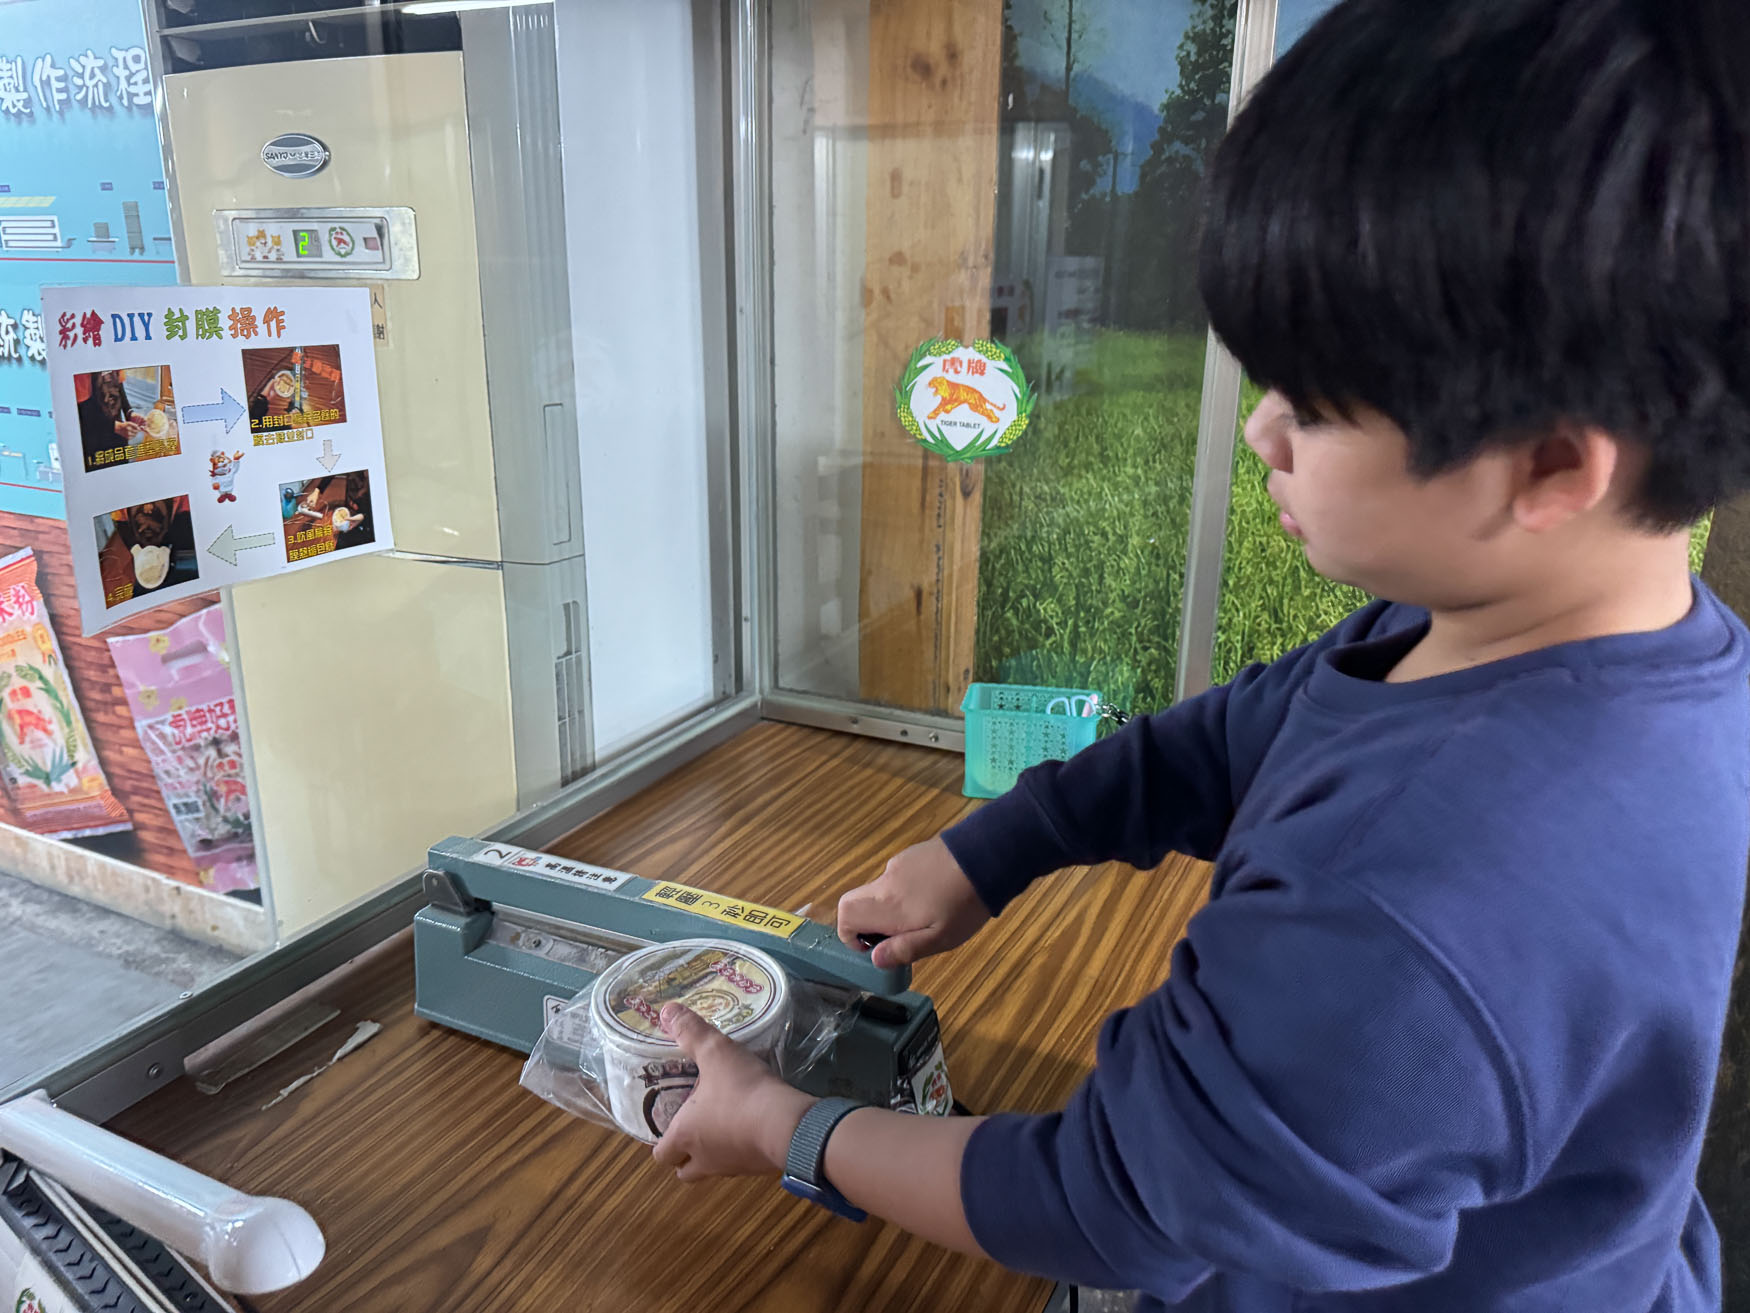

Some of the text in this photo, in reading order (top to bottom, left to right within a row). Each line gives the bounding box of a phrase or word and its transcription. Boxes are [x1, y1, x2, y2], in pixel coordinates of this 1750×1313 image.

[0, 47, 152, 113] 製作流程
[299, 232, 309, 255] 2
[58, 306, 286, 350] 彩繪 DIY 封膜操作
[942, 356, 987, 376] 虎牌
[941, 419, 981, 429] TIGER TABLET
